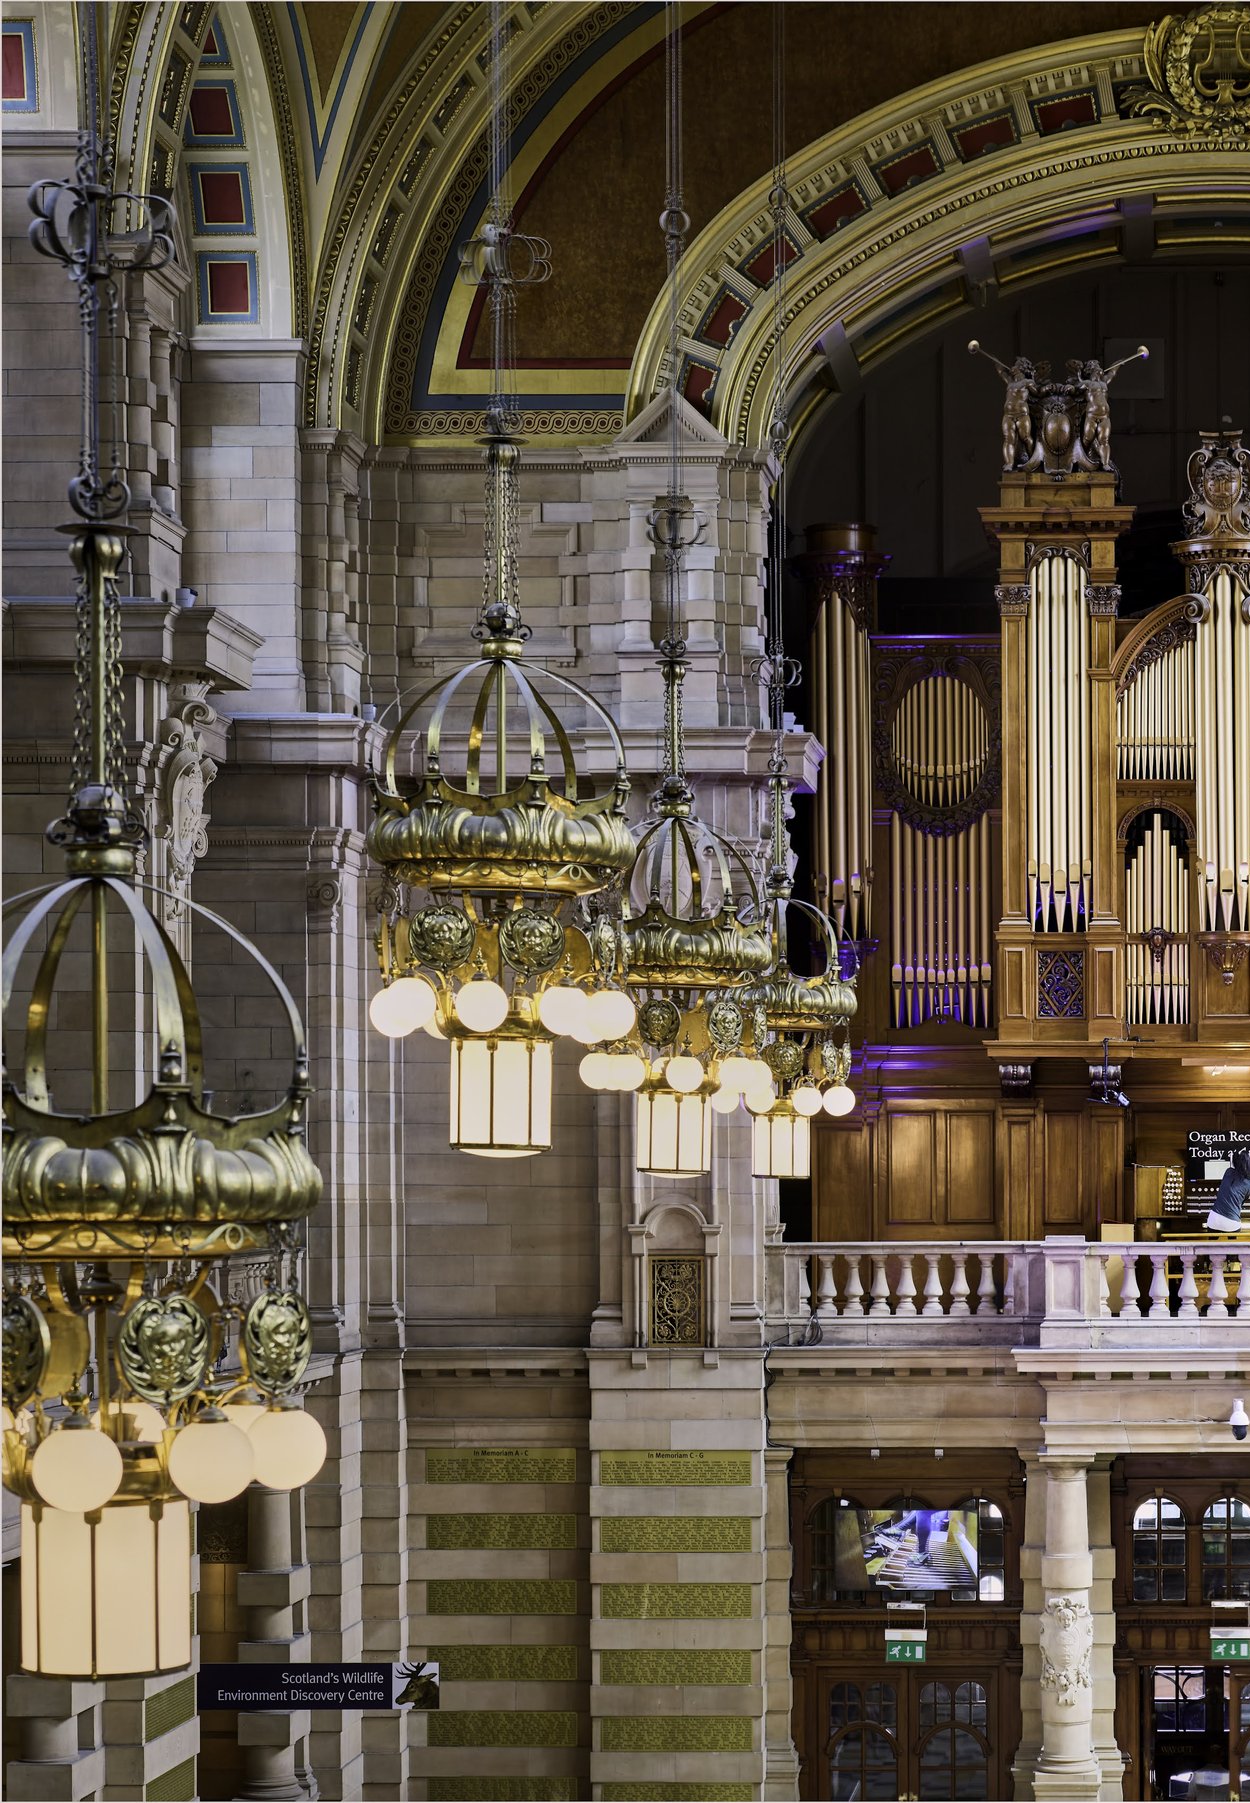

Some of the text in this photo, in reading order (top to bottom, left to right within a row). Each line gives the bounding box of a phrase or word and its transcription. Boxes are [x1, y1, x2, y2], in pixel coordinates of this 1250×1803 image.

[1188, 1131, 1226, 1145] Organ
[1188, 1147, 1225, 1160] Today
[341, 1672, 384, 1684] Wildlife
[217, 1689, 384, 1704] Environment Discovery Centre
